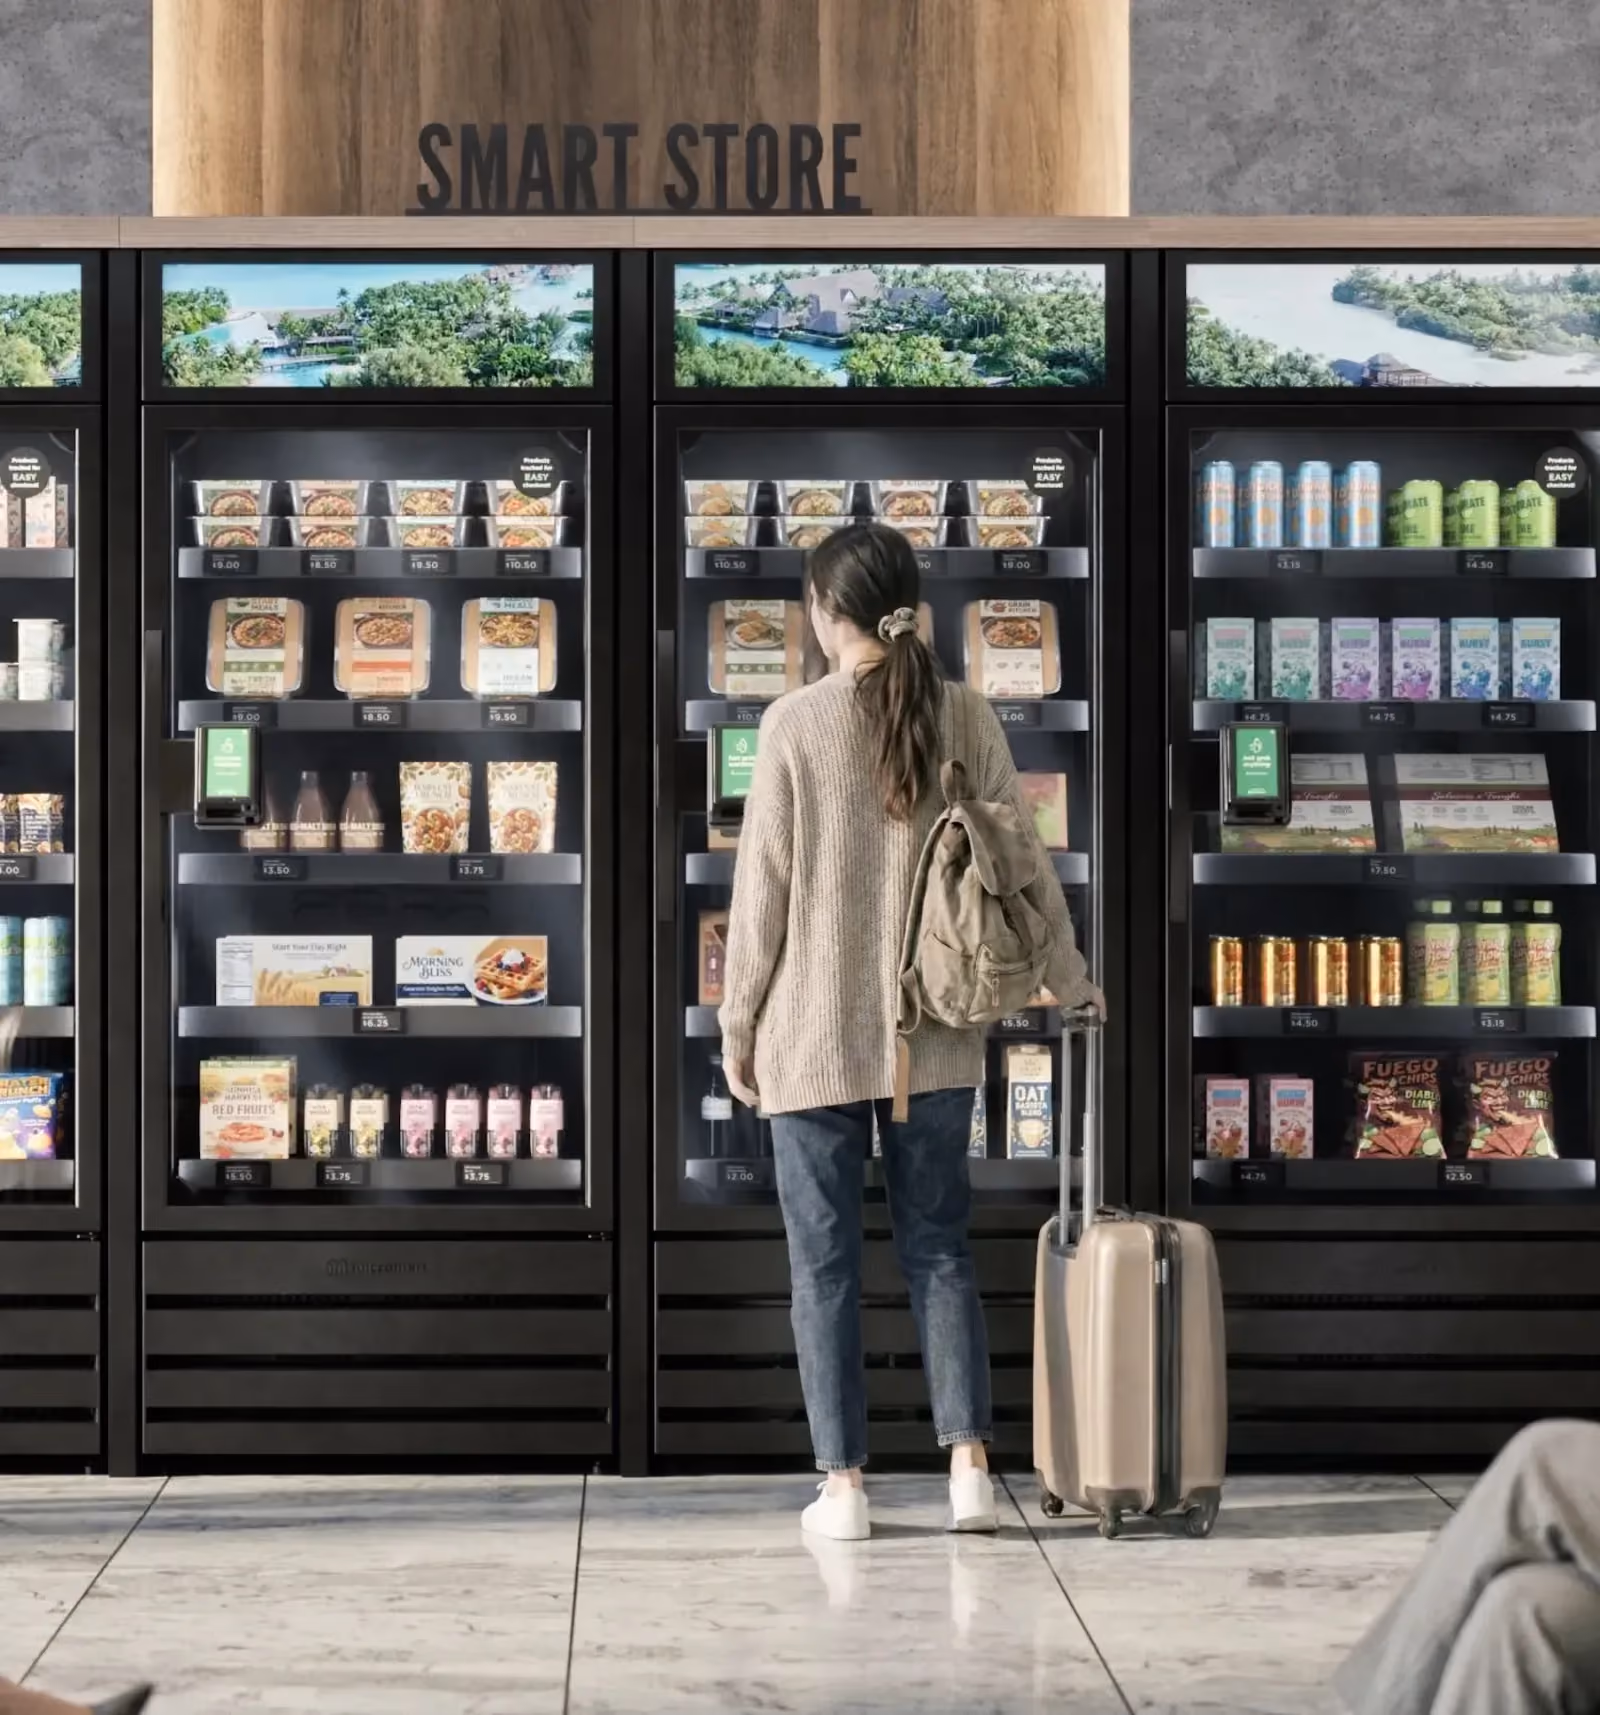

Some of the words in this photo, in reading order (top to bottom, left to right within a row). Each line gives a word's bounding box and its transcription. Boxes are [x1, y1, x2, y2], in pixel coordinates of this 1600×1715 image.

[417, 123, 638, 210] SMART
[664, 123, 861, 210] STORE
[12, 473, 37, 481] EASY
[524, 473, 549, 481] EASY
[1036, 473, 1061, 481] EASY
[1548, 473, 1574, 481] EASY
[264, 866, 290, 874] $3.50
[459, 866, 484, 874] $3.75
[326, 944, 347, 952] Right
[402, 956, 464, 970] MORNING
[419, 966, 453, 979] BLISS
[1002, 1020, 1029, 1028] $5.50
[1363, 1058, 1438, 1079] FUEGO
[1475, 1058, 1550, 1079] FUEGO
[1399, 1072, 1437, 1084] CHIPS
[1510, 1072, 1550, 1085] CHIPS
[1014, 1086, 1048, 1102] OAT
[212, 1104, 234, 1115] RED
[237, 1104, 276, 1115] FRUITS
[326, 1172, 350, 1181] $3.75
[464, 1173, 490, 1181] $3.75
[1446, 1173, 1472, 1181] $2.50
